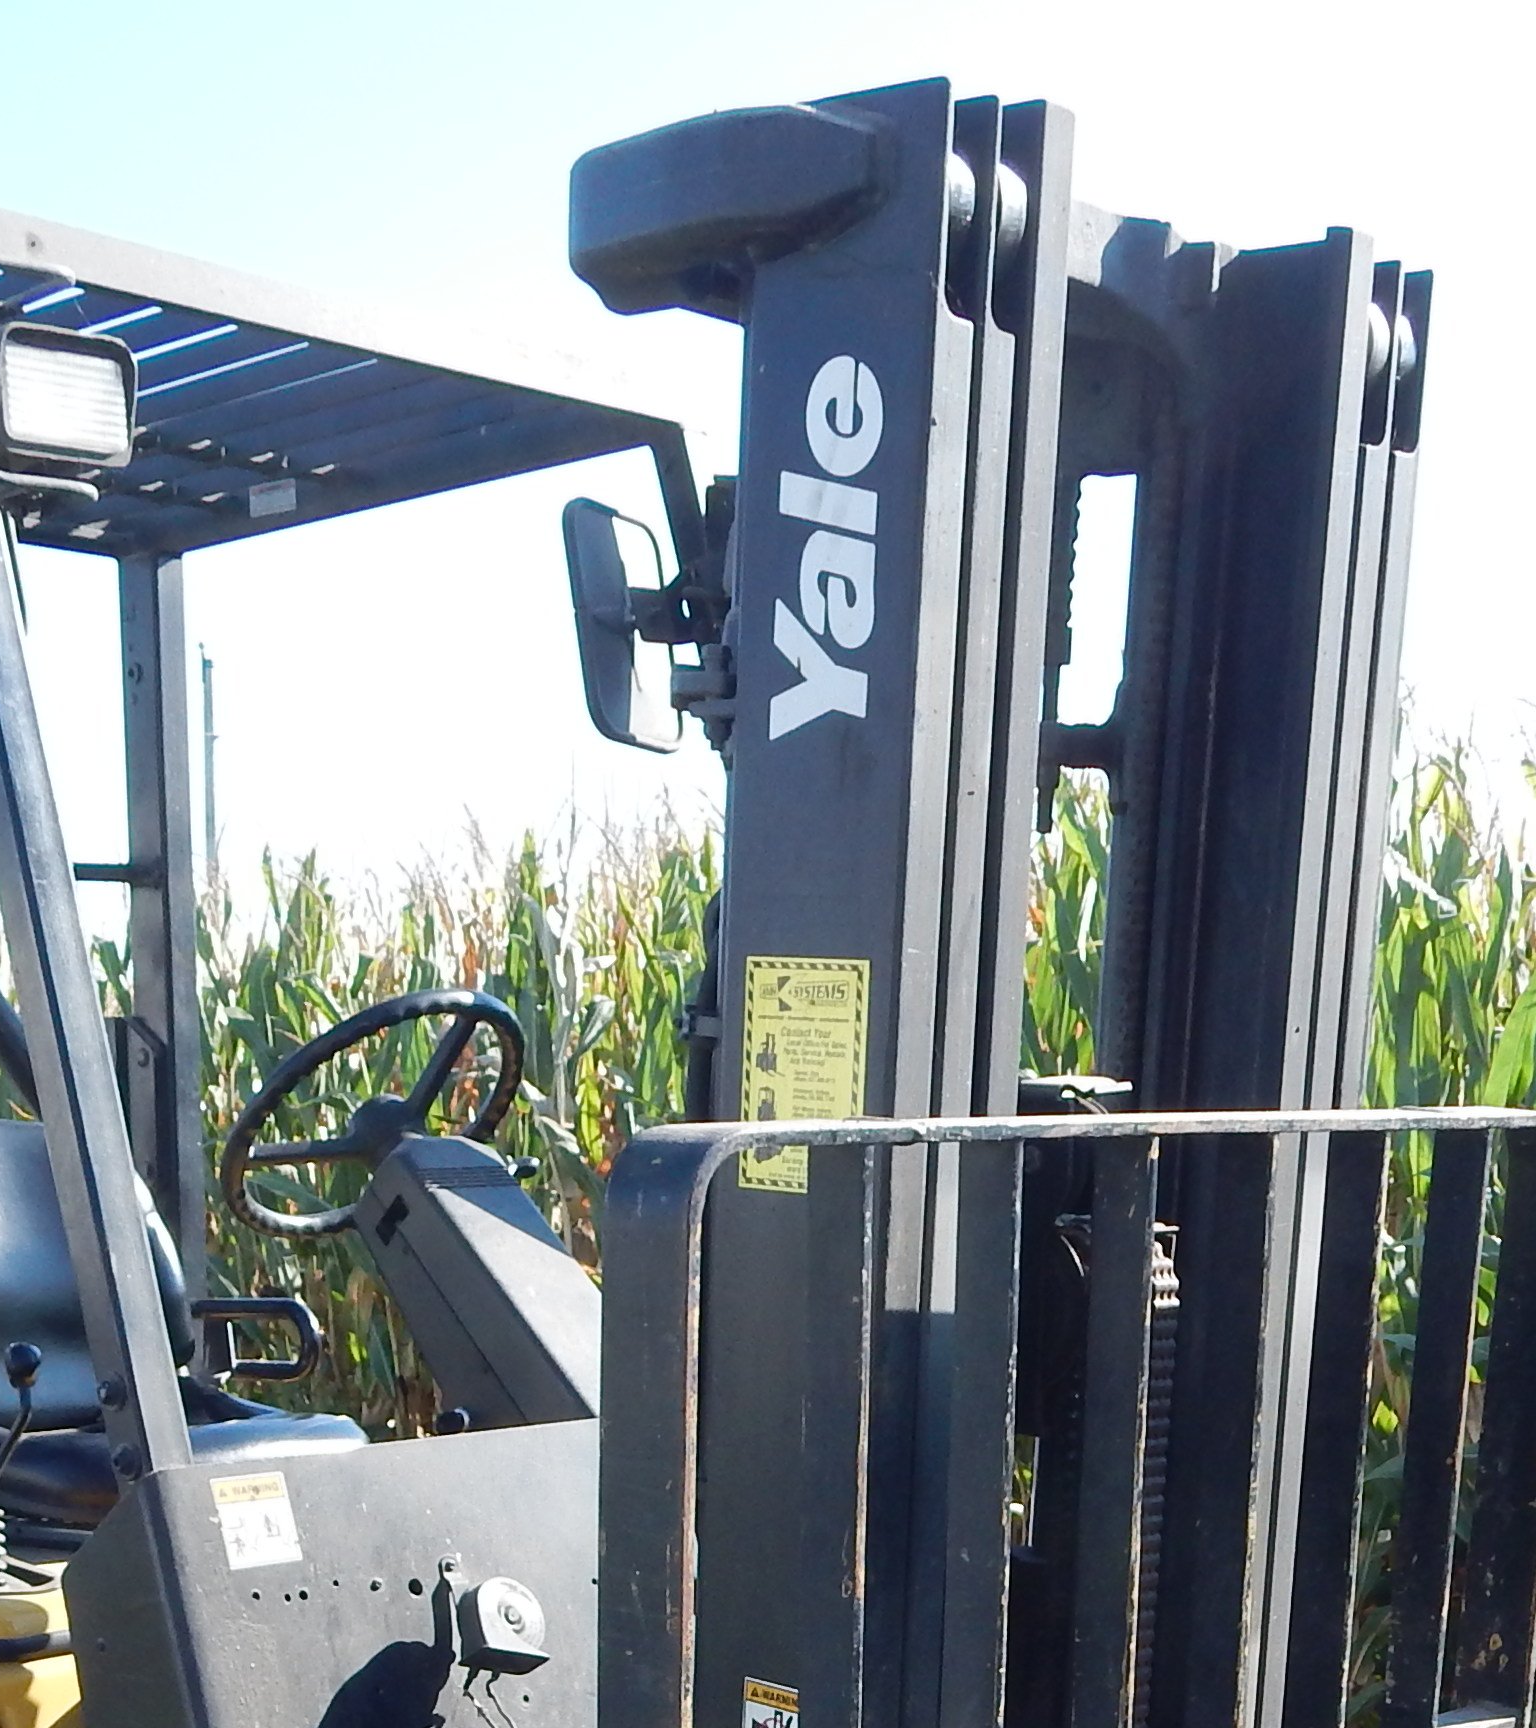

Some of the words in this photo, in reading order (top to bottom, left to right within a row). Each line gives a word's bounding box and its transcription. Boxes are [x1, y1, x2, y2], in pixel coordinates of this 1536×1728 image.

[769, 354, 884, 741] Yale
[233, 1482, 279, 1496] WARING
[762, 1689, 799, 1706] WARNIN
